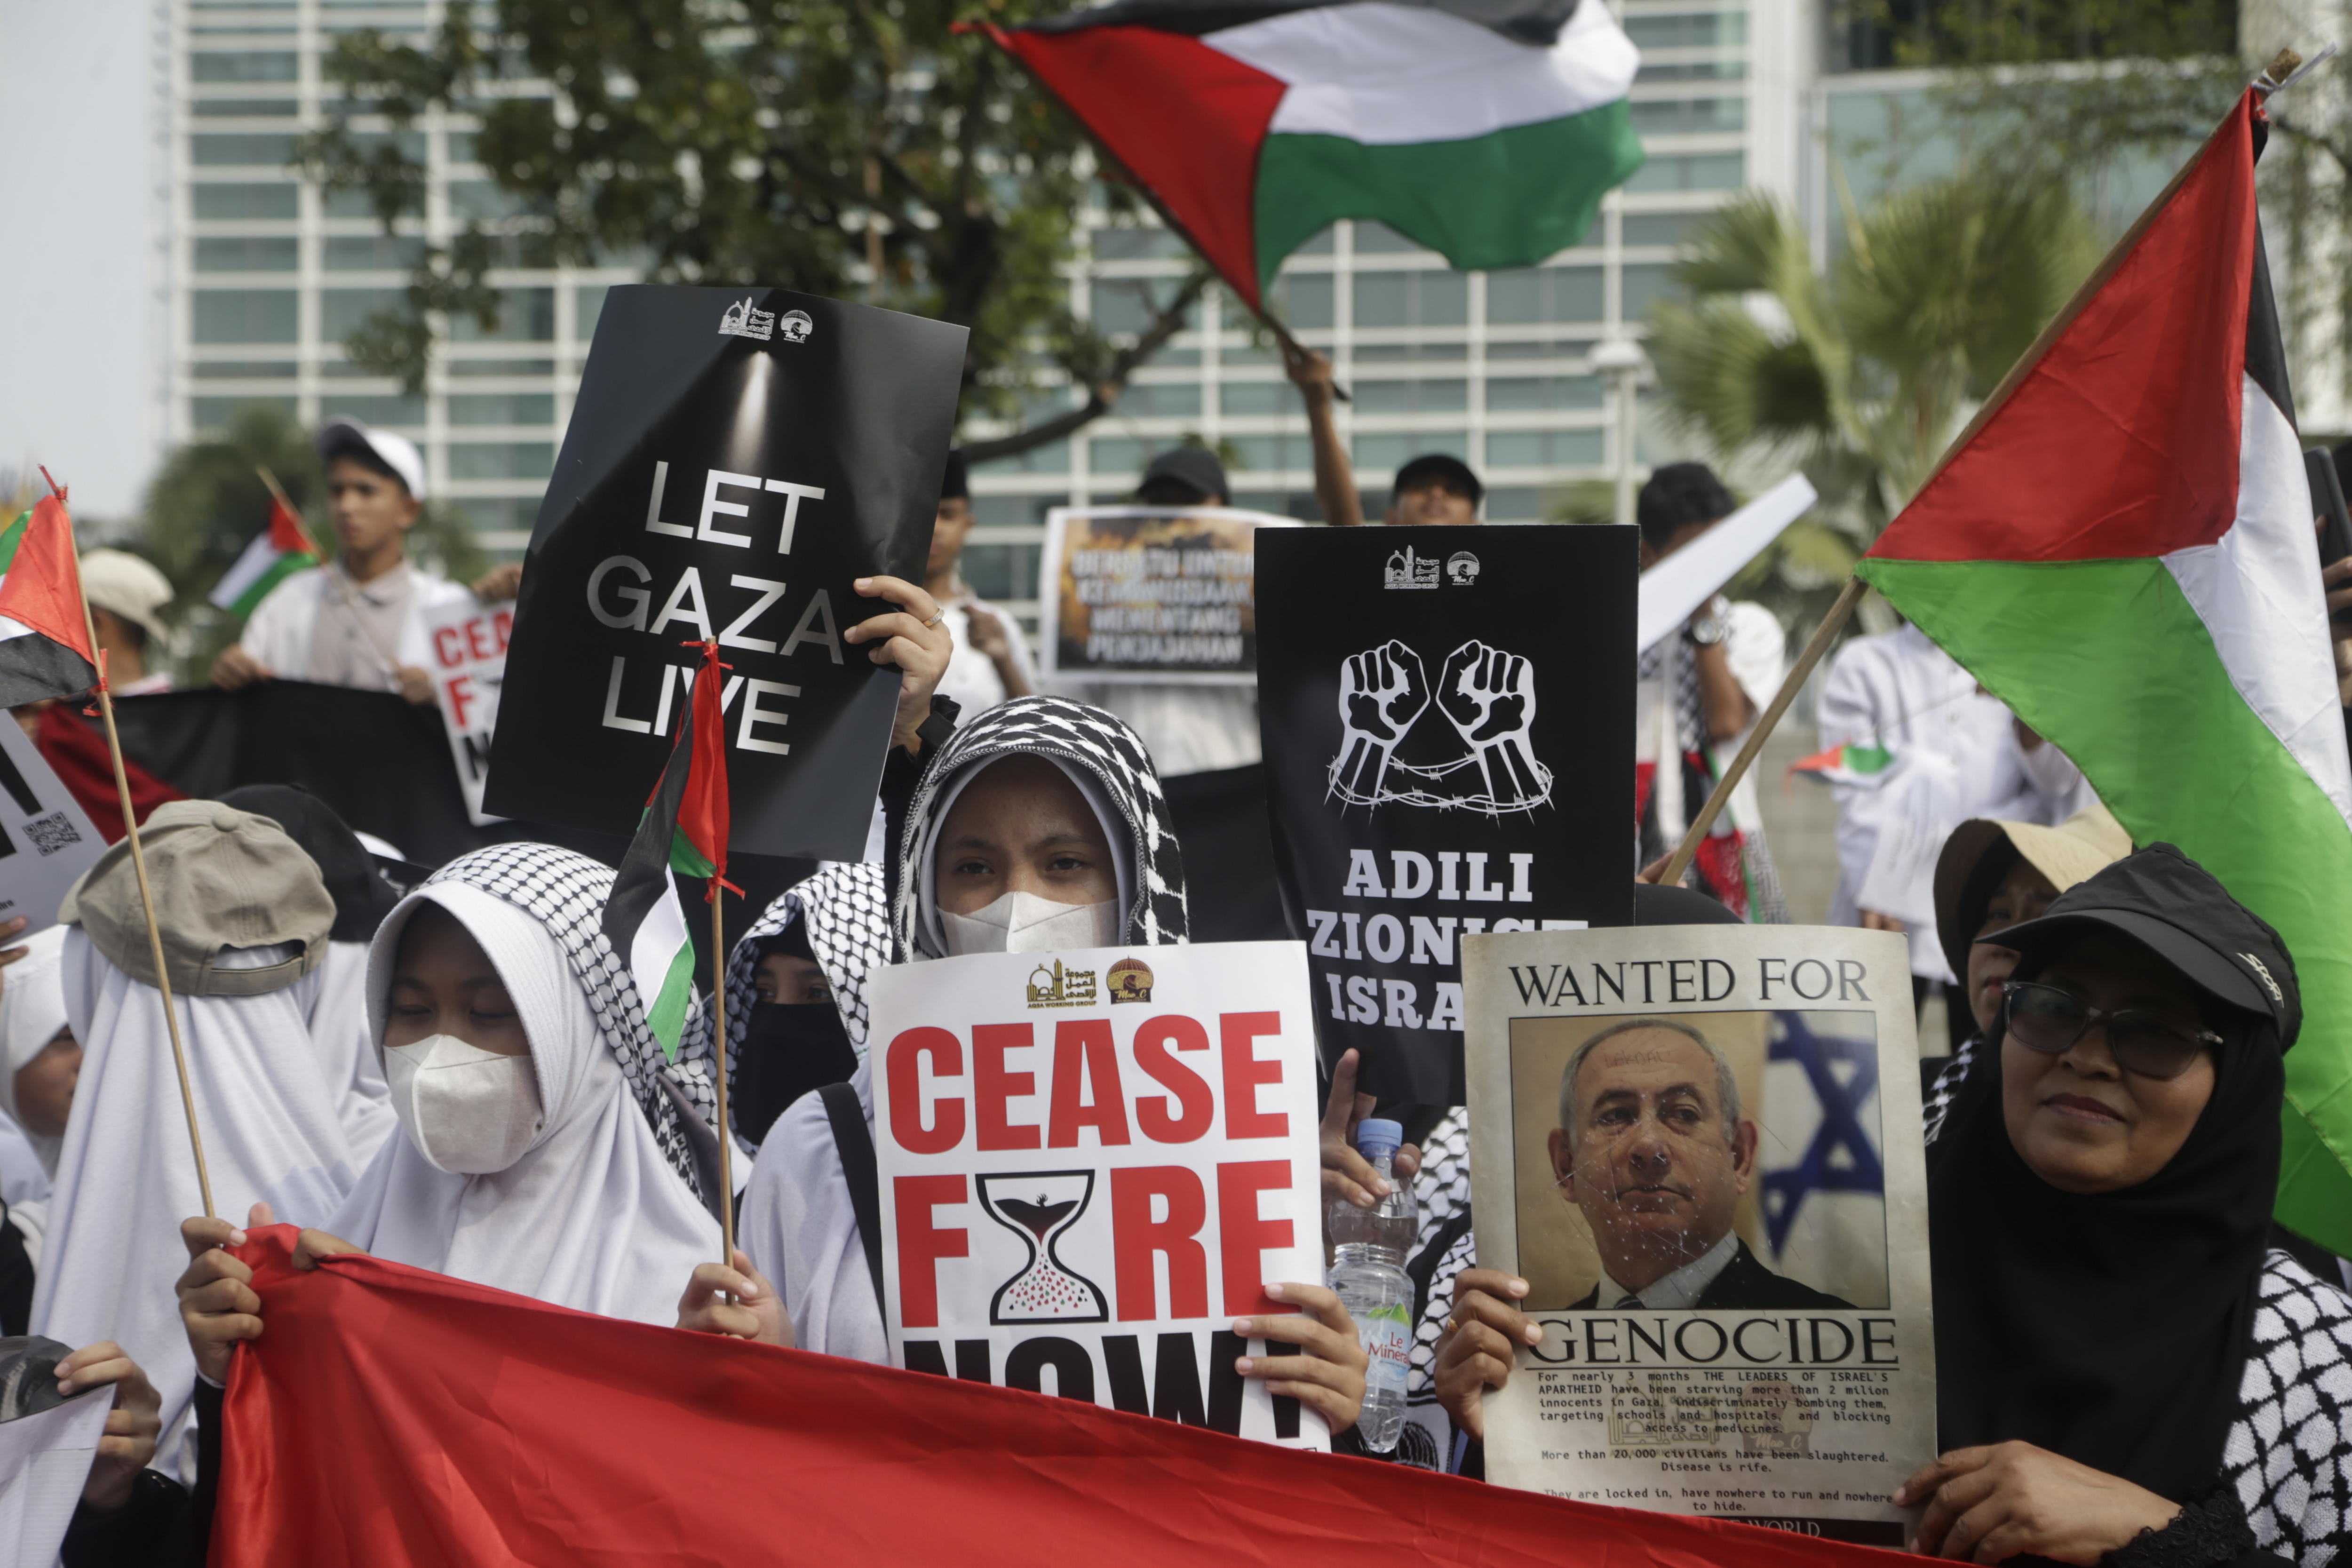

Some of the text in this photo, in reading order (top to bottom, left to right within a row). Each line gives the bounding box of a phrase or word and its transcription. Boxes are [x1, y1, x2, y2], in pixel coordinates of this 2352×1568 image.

[645, 461, 825, 554] LET
[1181, 549, 1255, 577] UNTU
[587, 555, 843, 664] GAZA
[433, 612, 513, 669] CEA
[1343, 849, 1534, 901] ADILI
[1306, 909, 1588, 965] ZION
[1509, 958, 1872, 1006] WANTED FOR
[1326, 972, 1464, 1031] ISRA
[886, 1011, 1290, 1154] CEASE
[1390, 1332, 1403, 1349] Le
[1527, 1318, 1899, 1364] GENOCIDE
[1368, 1342, 1410, 1364] Minera
[1539, 1371, 1888, 1382] For nearly 3 months THE LEADERS OF ISRAEL'S
[1539, 1385, 1602, 1394] APARTHEID
[1612, 1385, 1639, 1393] have
[1649, 1385, 1676, 1393] been
[1687, 1385, 1742, 1396] starving
[1792, 1385, 1819, 1394] than
[1846, 1386, 1889, 1395] milion
[1540, 1398, 1602, 1407] innocents
[1632, 1398, 1663, 1408] Gaza,
[1676, 1397, 1788, 1409] indiscriminately
[1796, 1399, 1846, 1410] bombing
[1855, 1400, 1886, 1410] them,
[1540, 1411, 1891, 1424] targeting schools and hospitals, and blocking
[1694, 1424, 1708, 1433] to
[1716, 1425, 1783, 1433] medicines.
[1542, 1451, 1569, 1459] More
[1578, 1450, 1605, 1458] than
[1614, 1449, 1656, 1460] 20,000
[1664, 1449, 1727, 1458] civilians
[1736, 1449, 1763, 1458] have
[1772, 1450, 1799, 1459] been
[1808, 1451, 1889, 1463] slaughtered.
[1661, 1462, 1772, 1472] Disease is rife.
[1606, 1489, 1648, 1498] locked
[1655, 1489, 1672, 1499] in,
[1682, 1488, 1710, 1497] have
[1716, 1489, 1765, 1498] nowhere
[1772, 1489, 1786, 1498] to
[1819, 1491, 1839, 1500] and
[1845, 1492, 1892, 1503] nowhere
[1693, 1502, 1746, 1511] to hide.
